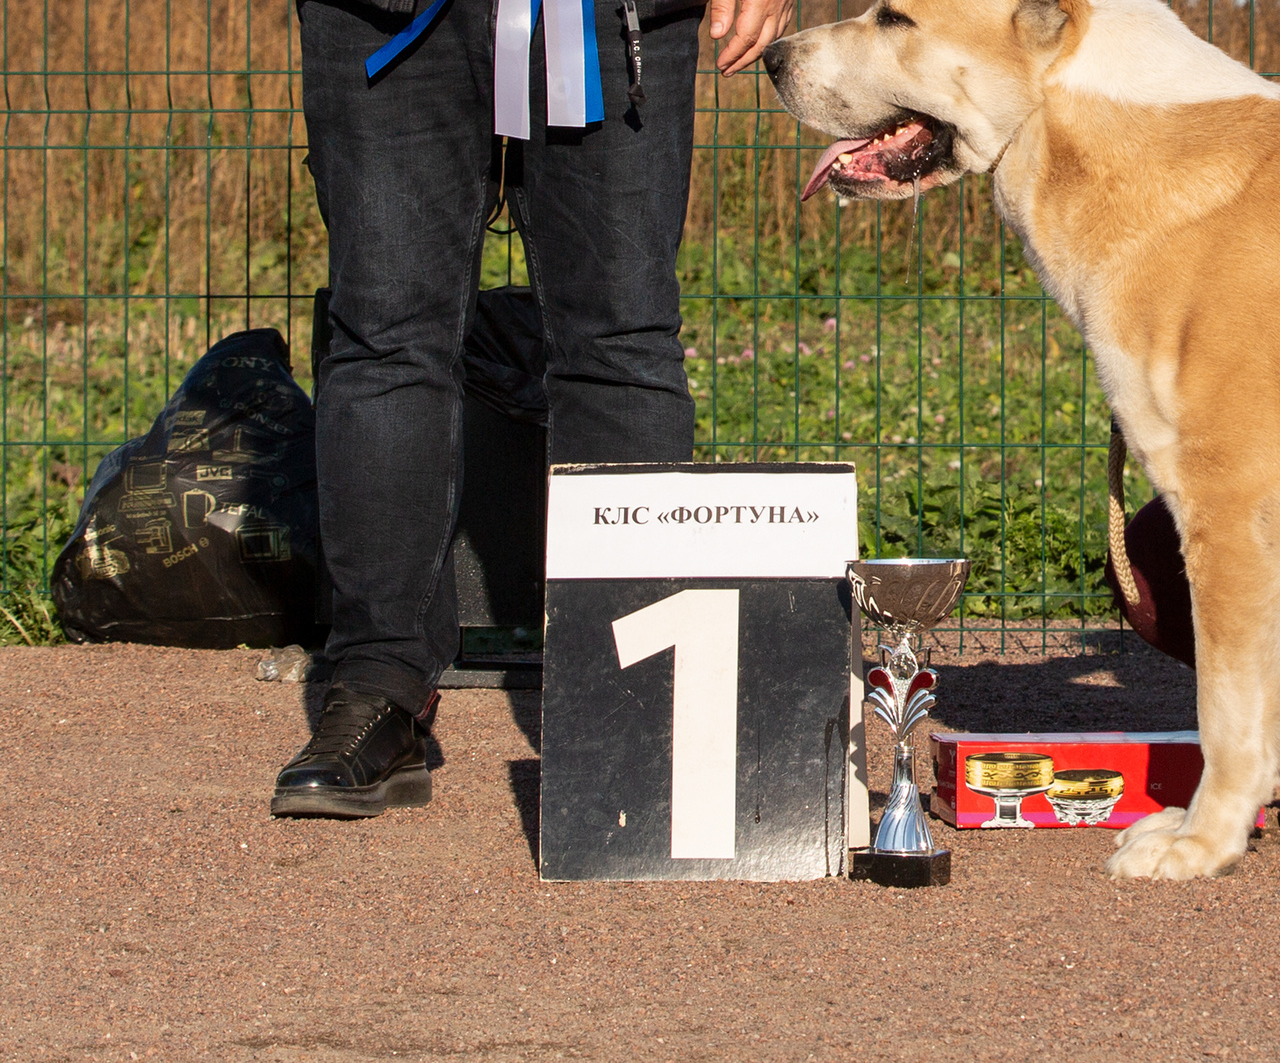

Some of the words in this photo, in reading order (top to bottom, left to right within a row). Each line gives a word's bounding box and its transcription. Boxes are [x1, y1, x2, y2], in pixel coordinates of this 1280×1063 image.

[214, 356, 275, 372] ONY
[199, 466, 230, 478] JVC
[220, 501, 267, 520] TEFAL
[592, 506, 650, 525] КЛС
[657, 505, 820, 525] «ФОРТУНА»
[163, 543, 199, 569] BOSCH
[611, 588, 740, 859] 1
